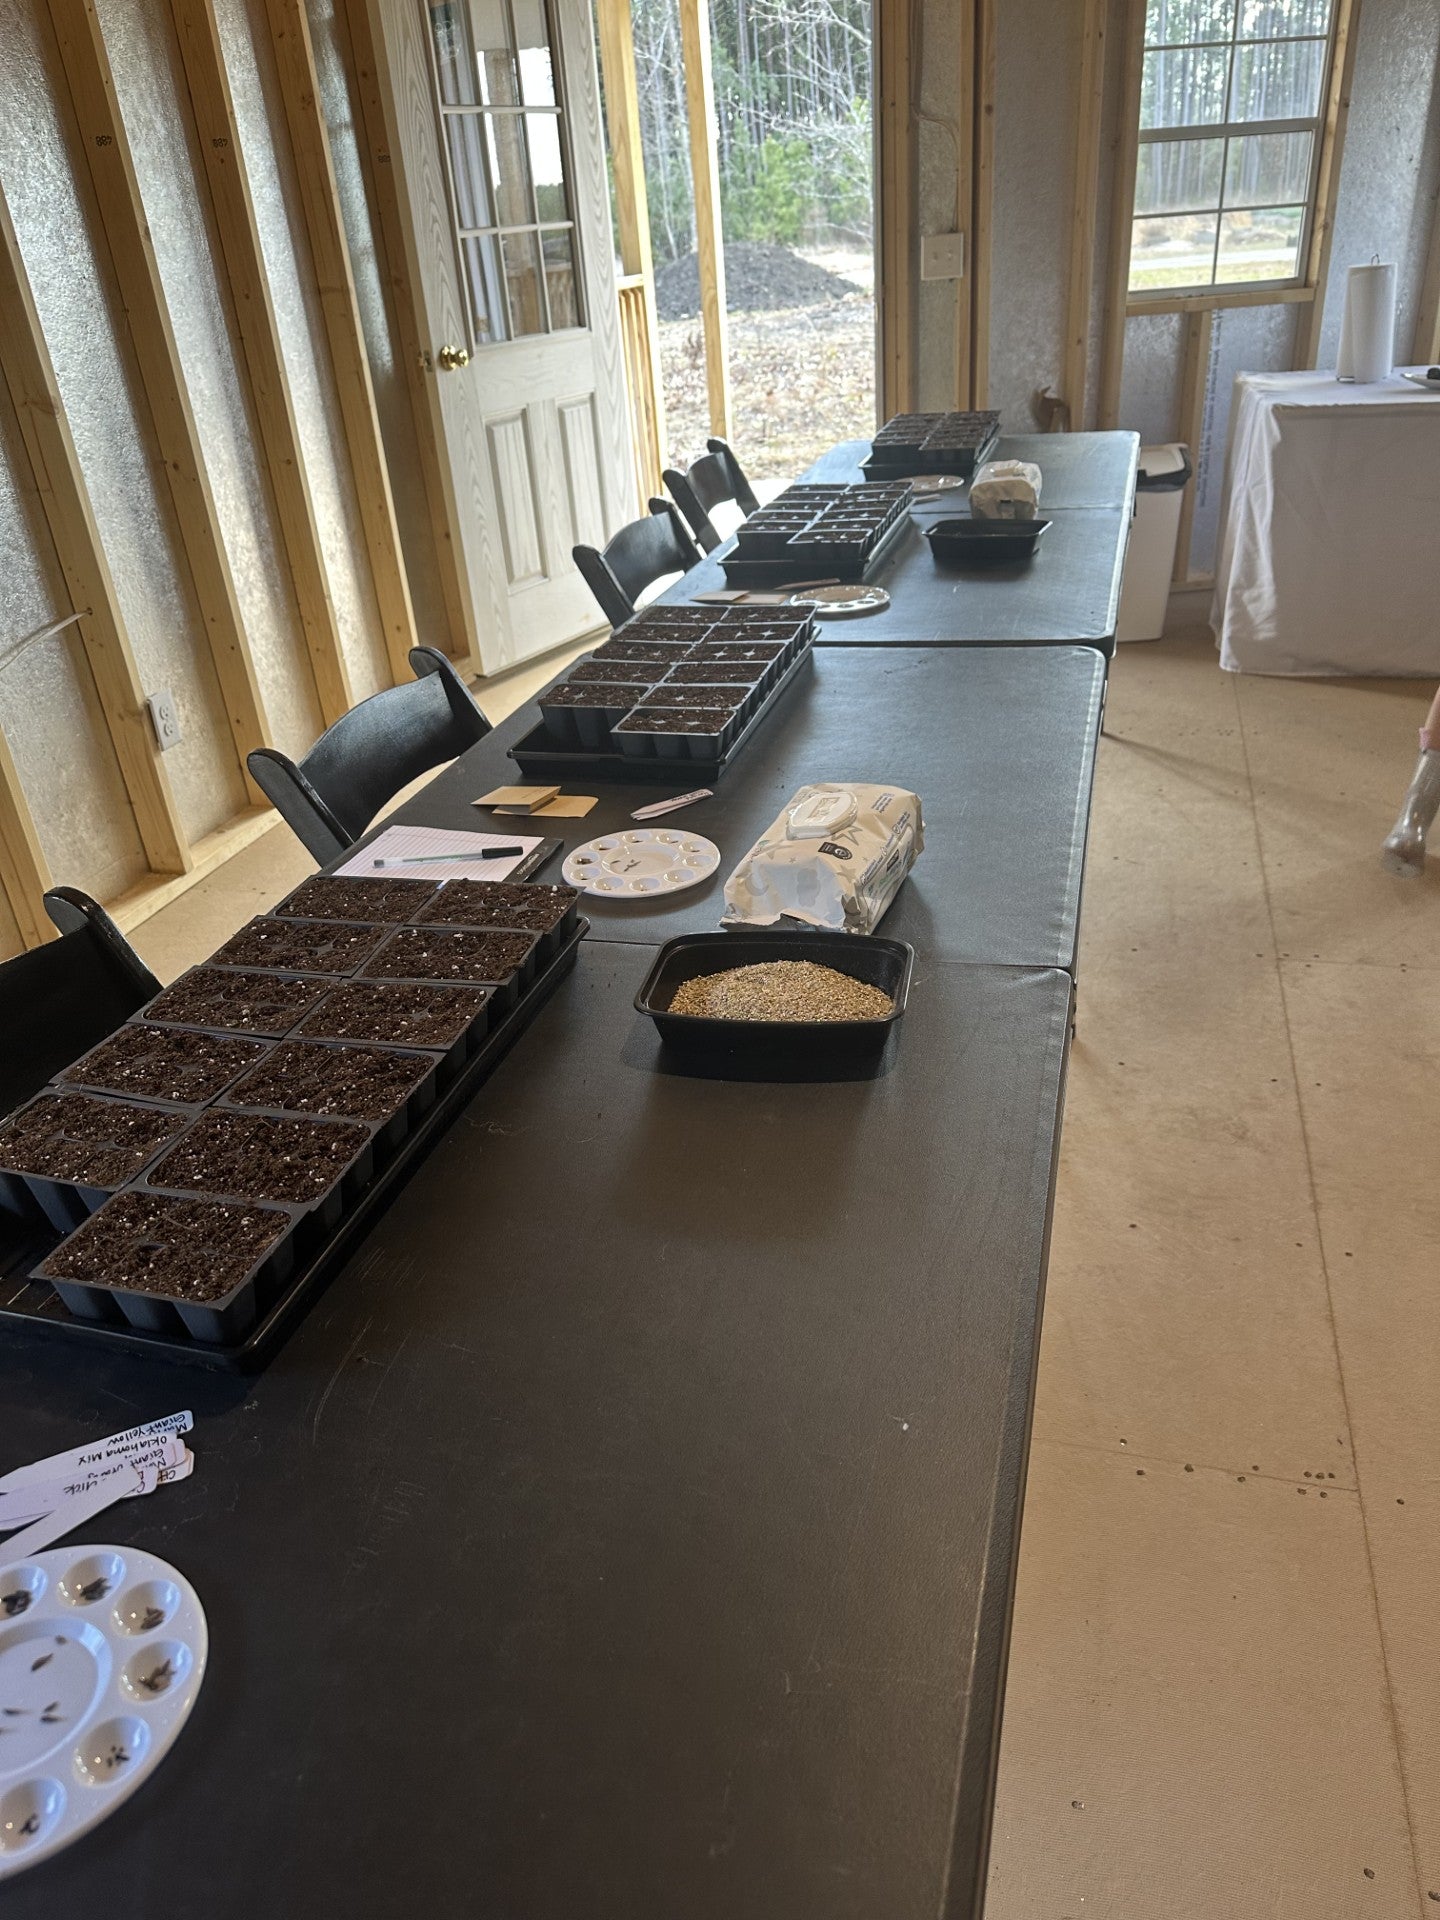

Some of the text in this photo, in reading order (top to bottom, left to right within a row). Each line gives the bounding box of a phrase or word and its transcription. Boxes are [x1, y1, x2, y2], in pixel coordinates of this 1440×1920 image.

[107, 1428, 145, 1447] Yellow
[78, 1436, 167, 1466] Oklahoma Mix
[130, 1448, 164, 1468] Giant
